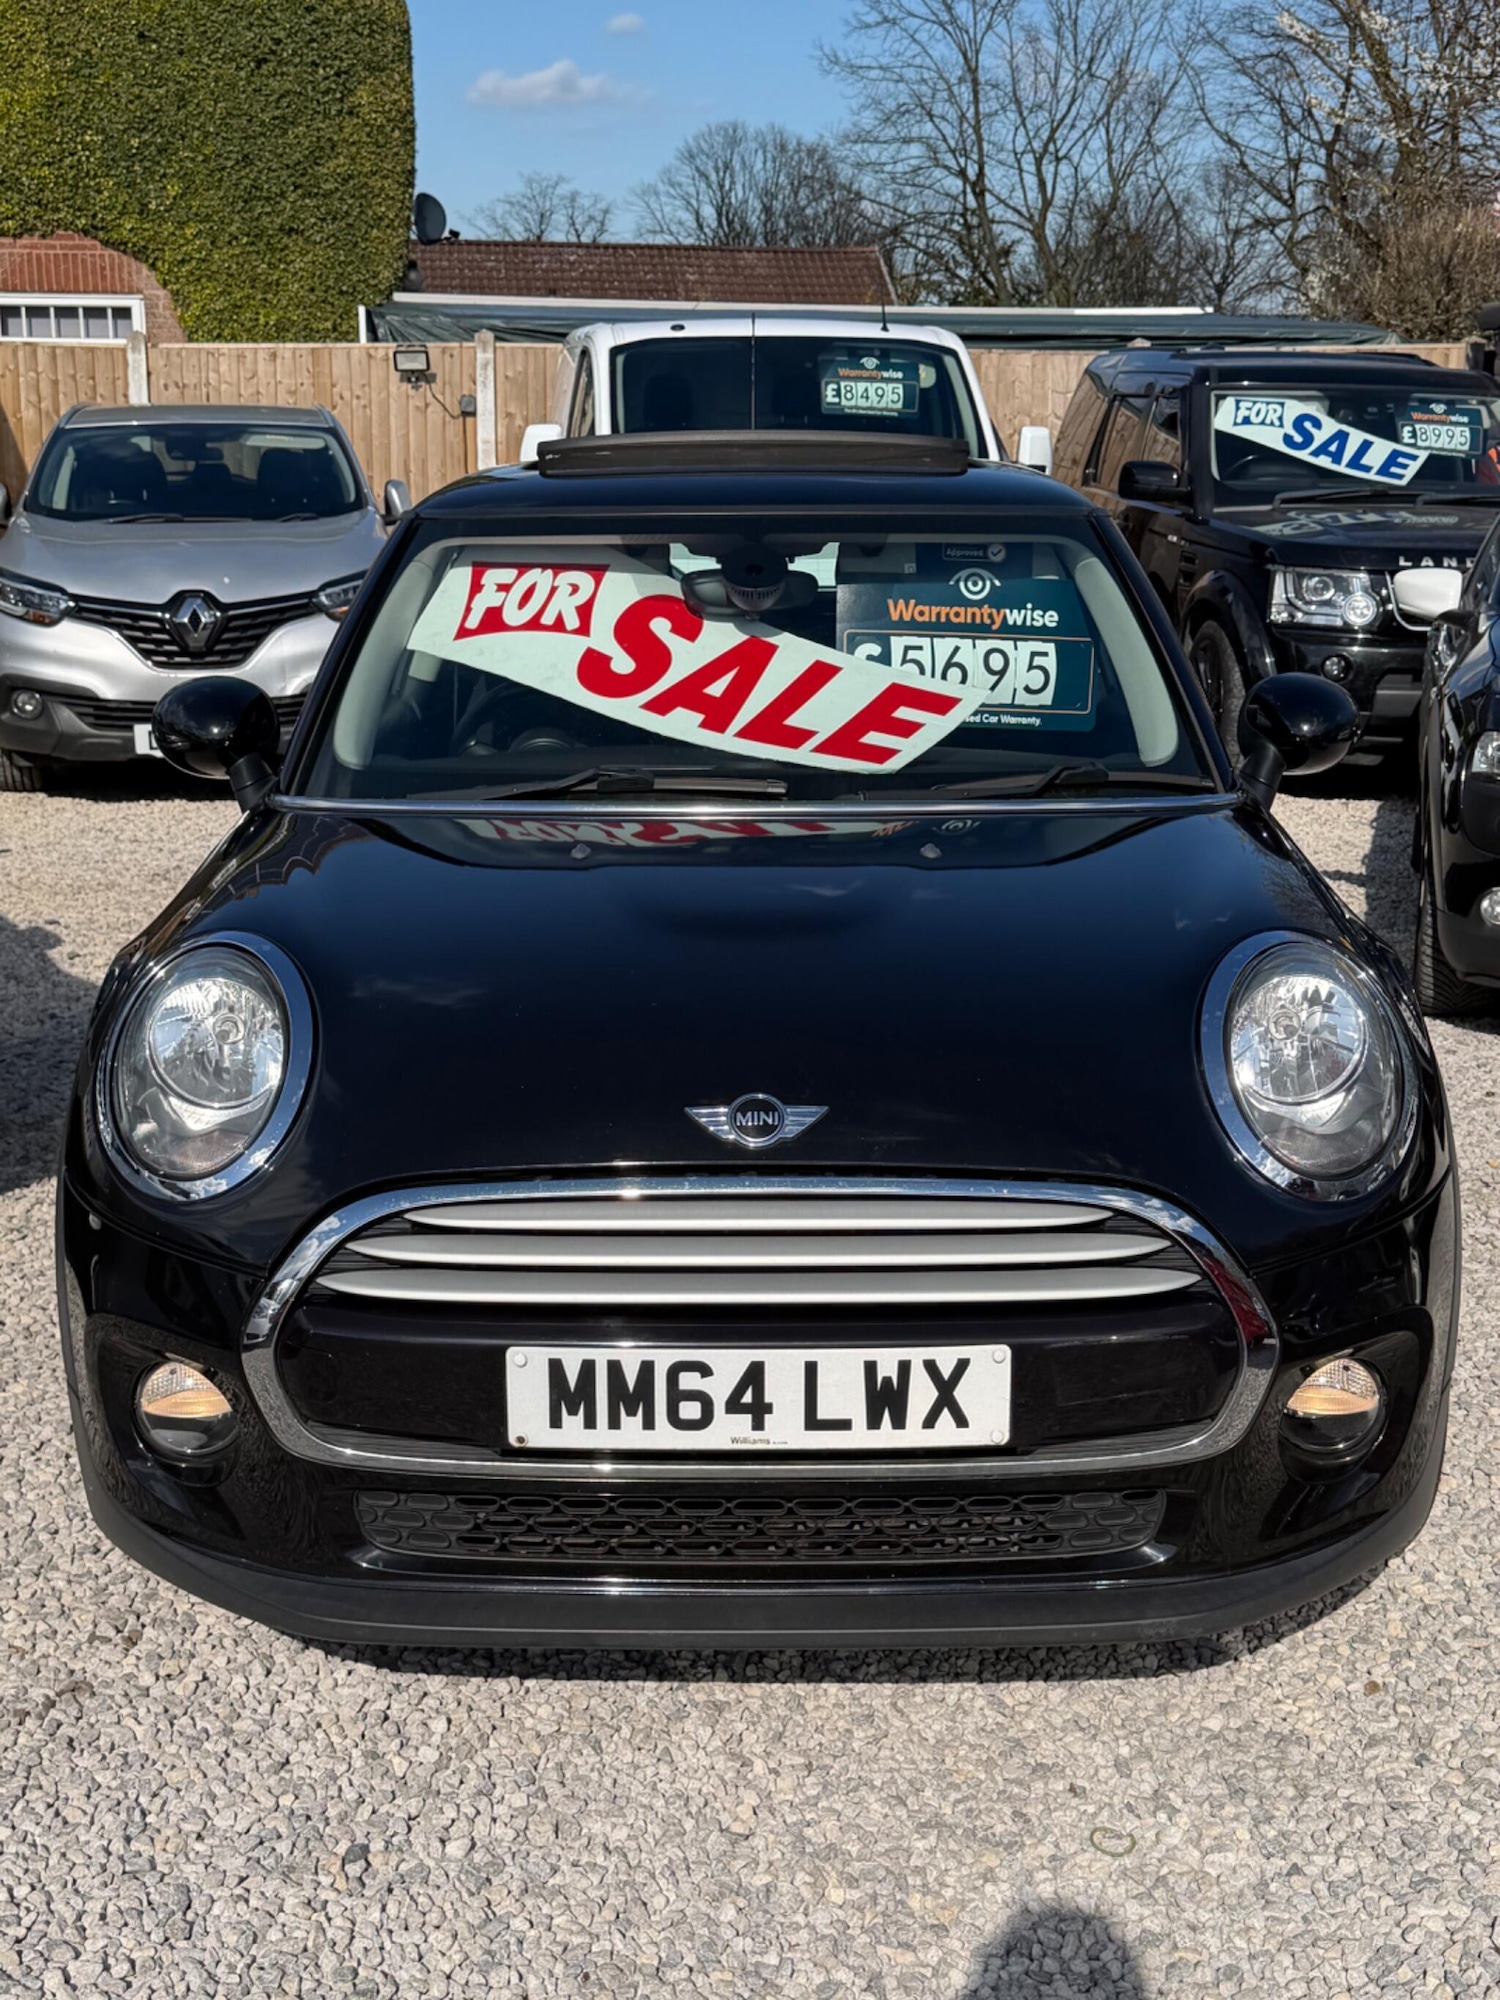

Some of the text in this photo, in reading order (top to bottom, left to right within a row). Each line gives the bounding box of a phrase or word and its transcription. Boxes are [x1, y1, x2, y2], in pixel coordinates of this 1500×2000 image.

[837, 368, 904, 379] Warrantywise
[826, 383, 901, 405] £8495
[1410, 411, 1470, 423] Warrantywise
[1236, 401, 1420, 481] FOR SALE
[1402, 426, 1469, 447] £8995
[946, 548, 984, 557] Approved
[887, 598, 1060, 631] Warrantywise
[463, 567, 963, 765] FOR SALE
[982, 713, 999, 723] Car
[736, 1111, 779, 1126] MINI
[547, 1357, 972, 1432] MM64 LWX
[730, 1436, 771, 1445] Williams
